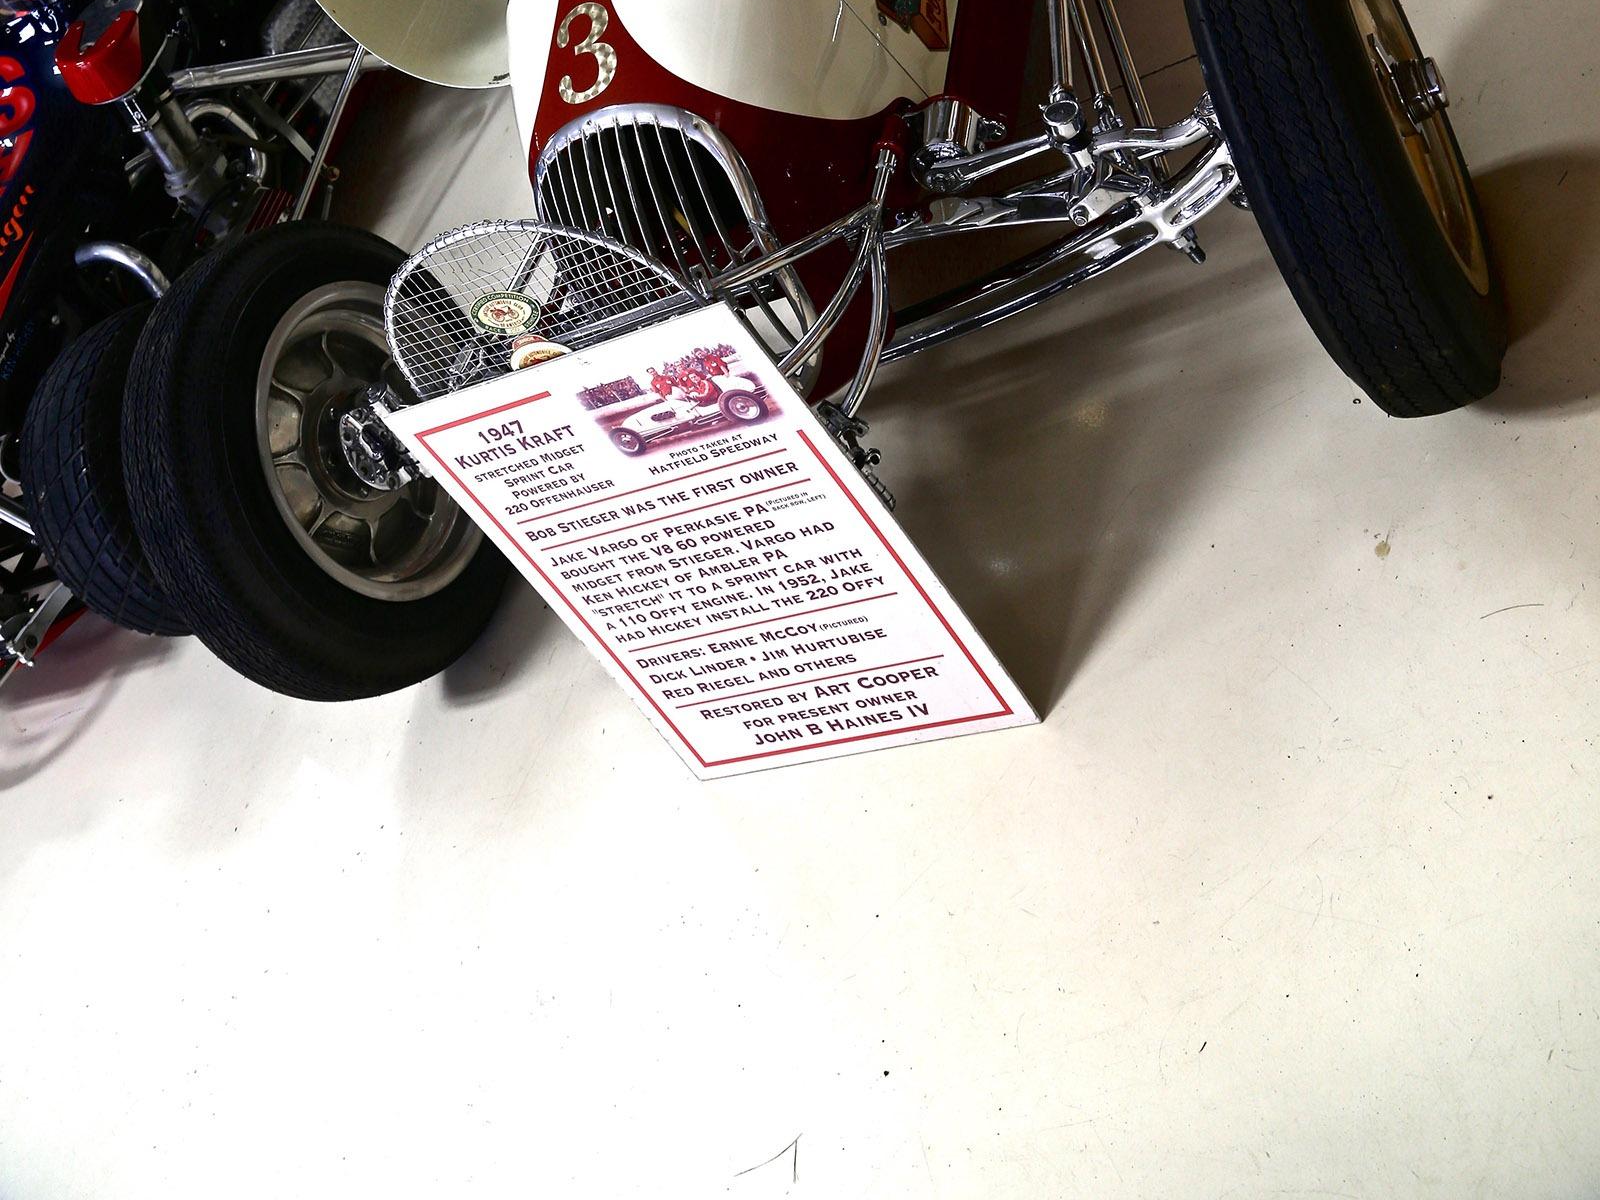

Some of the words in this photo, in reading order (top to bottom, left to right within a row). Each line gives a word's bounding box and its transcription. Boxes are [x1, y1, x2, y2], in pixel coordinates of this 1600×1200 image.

[556, 2, 618, 105] 3
[455, 443, 517, 469] KURTIS
[517, 425, 575, 451] KRAFT
[478, 420, 525, 444] 1947
[648, 454, 709, 476] HATFIELD
[712, 433, 779, 458] SPEEDWAY
[669, 447, 699, 459] PHOTO
[700, 438, 730, 450] TAKEN
[474, 458, 539, 482] STRETCHED
[539, 444, 586, 463] MIDGET
[504, 470, 548, 488] SPRINT
[548, 462, 575, 475] CAR
[512, 478, 568, 499] POWERED
[572, 473, 586, 484] BY
[505, 503, 529, 516] 220
[530, 479, 615, 508] OFFENHAUSER
[525, 527, 557, 542] BOB
[557, 510, 620, 533] STIEGER
[621, 500, 656, 517] WAS
[657, 491, 690, 507] THE
[692, 478, 736, 498] FIRST
[740, 461, 800, 484] OWNER
[550, 551, 588, 567] JAKE
[588, 538, 638, 557] VARGO
[641, 532, 659, 543] OF
[662, 511, 741, 538] PERKASIE
[743, 503, 769, 518] PA
[560, 559, 616, 580] BOUGHT
[619, 551, 650, 566] THE
[650, 544, 674, 557] V8
[676, 538, 698, 551] 60
[701, 519, 776, 545] POWERED
[572, 573, 622, 592] MIDGET
[626, 563, 667, 580] FROM
[668, 545, 740, 569] STIEGER.
[740, 531, 796, 551] VARGO
[799, 521, 835, 537] HAD
[582, 592, 613, 606] KEN
[615, 578, 670, 598] HICKEY
[674, 572, 693, 584] OF
[698, 556, 761, 578] AMBLER
[762, 549, 789, 562] PA
[592, 593, 665, 617] "STRETCH"
[669, 591, 682, 600] IT
[686, 586, 707, 597] TO
[711, 582, 723, 591] A
[725, 568, 779, 587] SPRINT
[783, 559, 817, 574] CAR
[819, 548, 863, 565] WITH
[606, 622, 617, 631] A
[619, 613, 647, 627] 110
[650, 605, 688, 620] OFFY
[691, 591, 753, 611] ENGINE.
[755, 585, 775, 596] IN
[778, 574, 827, 591] 1952,
[830, 562, 873, 580] JAKE
[615, 630, 646, 643] HAD
[647, 617, 702, 636] HICKEY
[706, 603, 770, 623] INSTALL
[771, 594, 805, 608] THE
[806, 585, 839, 601] 220
[842, 576, 886, 592] OFFY
[636, 647, 706, 669] DRIVERS:
[707, 636, 758, 654] ERNIE
[819, 615, 869, 632] (PICTURED)
[649, 670, 688, 685] DICK
[688, 657, 748, 676] LINDER
[761, 649, 789, 663] JIM
[791, 628, 888, 655] HURTUBISE
[662, 687, 695, 700] RED
[696, 675, 755, 694] RIEGEL
[758, 667, 791, 681] AND
[793, 653, 857, 673] OTHERS
[700, 697, 784, 720] RESTORED
[787, 692, 809, 703] BY
[814, 682, 852, 698] ART
[857, 666, 940, 689] COOPER
[743, 717, 775, 730] FOR
[777, 702, 852, 723] PRESENT
[855, 690, 918, 709] OWNER
[754, 728, 804, 746] JOHN
[806, 723, 824, 735] B
[826, 710, 903, 732] HAINES
[906, 703, 930, 718] IV
